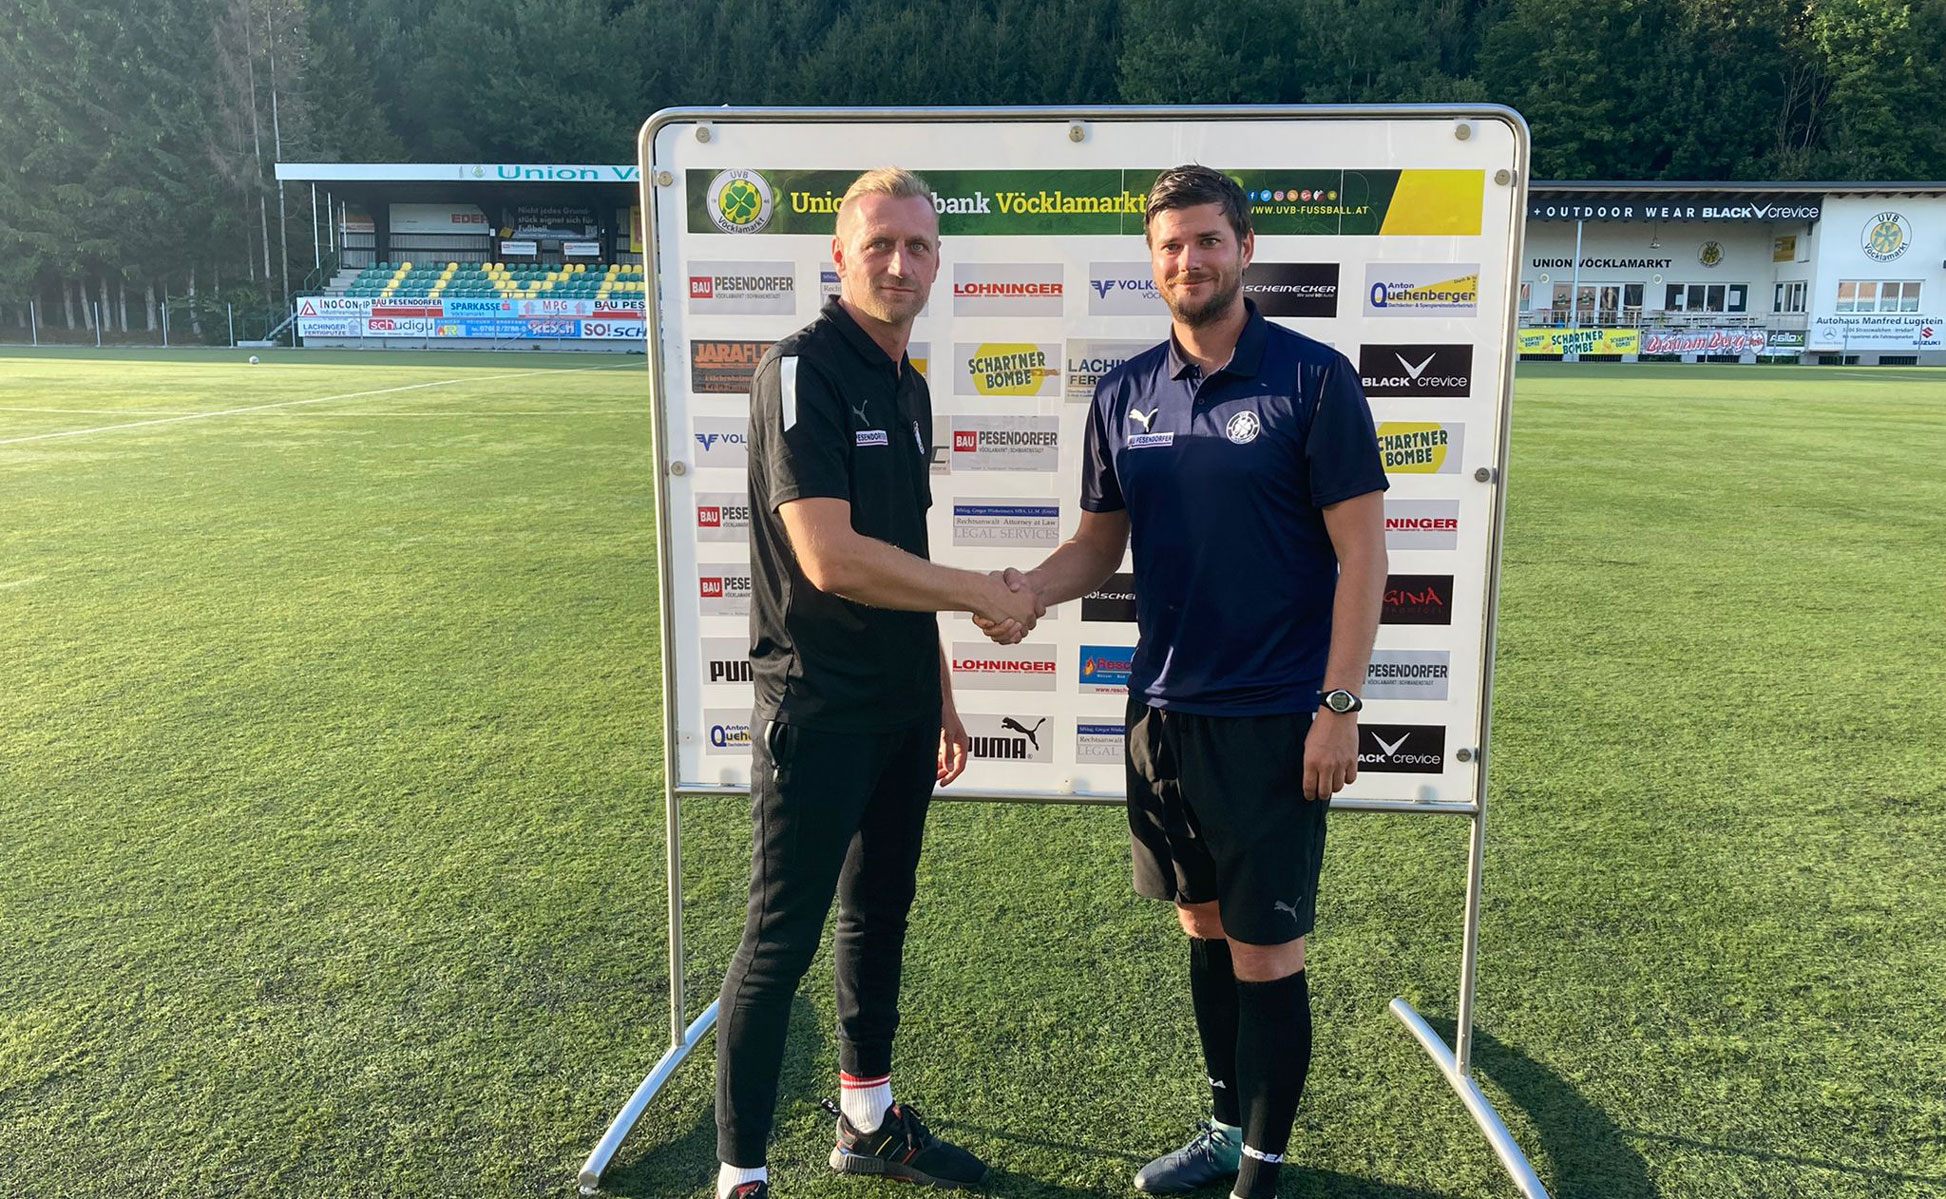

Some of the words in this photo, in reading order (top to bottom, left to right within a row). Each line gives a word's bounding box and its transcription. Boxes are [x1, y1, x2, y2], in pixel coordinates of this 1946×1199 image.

[498, 166, 599, 180] Union
[730, 171, 749, 179] UVB
[995, 191, 1147, 214] Vöcklamarkt
[540, 207, 562, 216] jedes
[1546, 206, 1633, 218] OUTDOOR
[1645, 207, 1695, 218] WEAR
[1702, 207, 1752, 218] BLACK
[1767, 205, 1819, 218] crevice
[1877, 213, 1900, 222] UVB
[518, 215, 539, 223] stück
[540, 216, 565, 225] eignet
[566, 215, 582, 223] sich
[583, 215, 593, 223] für
[718, 216, 765, 233] Vöcklamarkt
[1864, 242, 1908, 261] Vöcklamarkt
[1533, 259, 1573, 268] UNION
[692, 281, 711, 293] BAU
[714, 276, 794, 291] PESENDORFER
[954, 283, 1063, 294] LOHNINGER
[1370, 282, 1476, 308] Quehenberger
[371, 298, 387, 308] BAU
[388, 298, 443, 306] PESENDORFER
[450, 302, 501, 311] SPARKASSE
[594, 301, 618, 310] BAU
[1816, 317, 1860, 325] Autohaus
[1861, 317, 1902, 325] Manfred
[1904, 317, 1943, 327] Lugstein
[1551, 330, 1604, 346] SCHARTNER
[1562, 342, 1594, 354] BOMBE
[968, 351, 1046, 375] SCHARTNER
[985, 369, 1032, 389] BOMBE
[1361, 377, 1410, 388] BLACK
[1417, 375, 1468, 388] crevice
[956, 435, 975, 447] BAU
[978, 431, 1058, 446] PESENDORFER
[1385, 447, 1433, 467] BOMBE
[699, 510, 718, 523] BAU
[722, 506, 749, 520] PESE
[1003, 518, 1032, 526] Attorney
[1385, 518, 1458, 529] NINGER
[954, 527, 996, 539] LEGAL
[1000, 528, 1059, 540] SERVICES
[702, 581, 721, 593] BAU
[724, 577, 751, 590] PESE
[953, 659, 1056, 672] LOHNINGER
[1367, 663, 1448, 678] PESENDORFER
[1077, 746, 1120, 756] LEGAL
[1392, 752, 1441, 765] crevice
